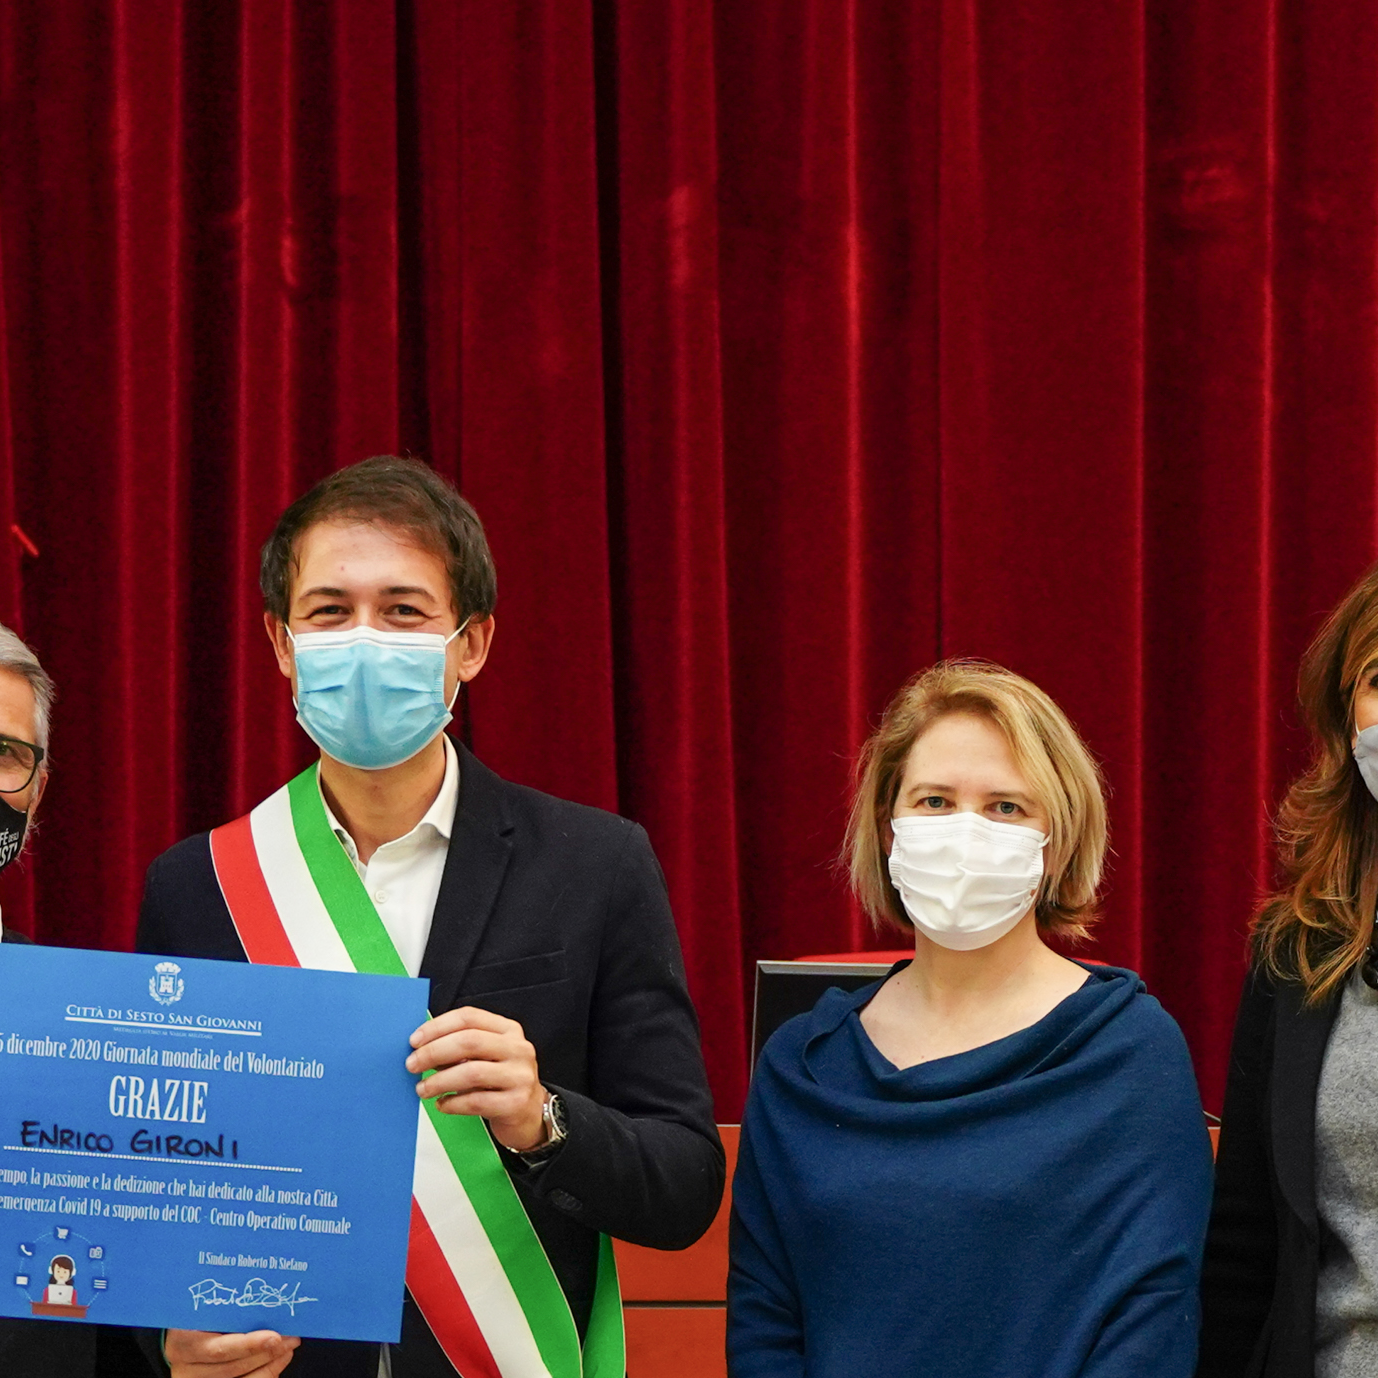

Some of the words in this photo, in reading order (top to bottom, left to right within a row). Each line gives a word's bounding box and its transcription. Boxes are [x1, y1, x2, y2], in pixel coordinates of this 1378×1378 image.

[126, 1009, 165, 1023] SESTO
[168, 1013, 193, 1025] SAN
[196, 1015, 262, 1031] GIOVANNI
[7, 1033, 67, 1058] dicembre
[69, 1038, 101, 1060] 2020
[103, 1041, 159, 1066] Giornata
[161, 1048, 221, 1070] mondiale
[223, 1050, 244, 1073] del
[247, 1052, 325, 1079] Volontariato
[108, 1075, 209, 1124] GRAZIE
[20, 1120, 114, 1153] ENRICO
[130, 1129, 239, 1160] GIRONI
[30, 1167, 41, 1185] la
[43, 1170, 90, 1189] passione
[92, 1177, 100, 1189] e
[101, 1173, 111, 1191] la
[113, 1174, 166, 1195] dedizione
[167, 1178, 187, 1196] che
[188, 1179, 206, 1198] hai
[208, 1181, 253, 1201] dedicato
[255, 1185, 275, 1204] alla
[277, 1189, 311, 1206] nostra
[313, 1188, 339, 1208] Città
[58, 1196, 88, 1215] Covid
[89, 1198, 102, 1216] 19
[103, 1203, 110, 1217] a
[112, 1204, 160, 1222] supporto
[161, 1204, 179, 1223] del
[180, 1206, 202, 1224] COC
[209, 1207, 245, 1228] Centro
[246, 1210, 297, 1232] Operativo
[298, 1214, 352, 1235] Comunale
